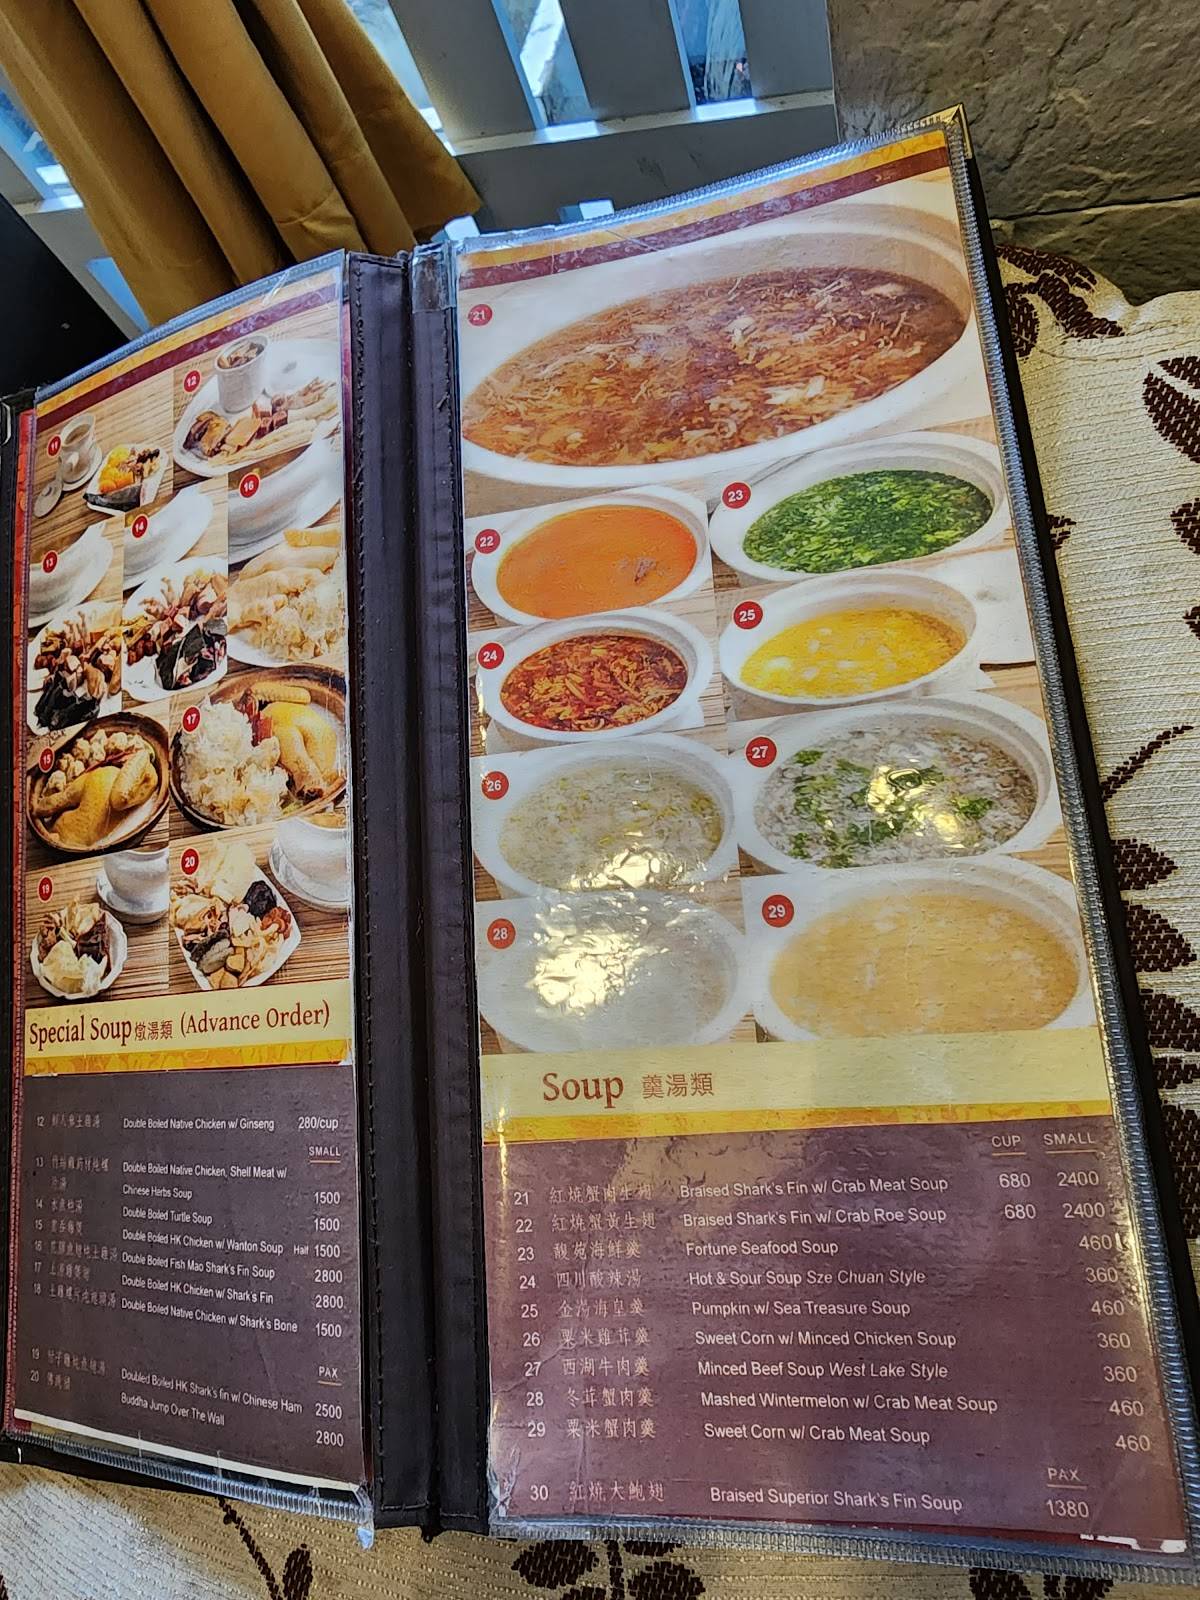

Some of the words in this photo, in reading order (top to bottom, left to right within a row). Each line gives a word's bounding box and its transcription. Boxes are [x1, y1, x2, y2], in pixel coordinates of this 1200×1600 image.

[728, 490, 743, 501] 23
[480, 536, 494, 547] 22
[740, 610, 755, 621] 25
[483, 651, 497, 662] 24
[752, 746, 768, 758] 27
[488, 780, 502, 792] 26
[185, 857, 195, 867] 20
[768, 906, 786, 918] 29
[493, 928, 508, 940] 28
[30, 1016, 84, 1050] Special
[90, 1017, 132, 1046] Soup
[134, 1020, 173, 1040] 燉湯類
[180, 1011, 260, 1038] (Advance
[266, 1000, 330, 1029] Order)
[542, 1073, 625, 1108] Soup
[642, 1072, 714, 1098] 羹湯類
[124, 1118, 146, 1128] Double
[148, 1118, 168, 1128] Boiled
[170, 1118, 193, 1129] Native
[195, 1118, 226, 1129] Chicken
[228, 1118, 238, 1129] w/
[240, 1118, 274, 1132] Ginseng
[298, 1116, 338, 1130] 280/cup
[992, 1136, 1021, 1147] CUP
[1043, 1133, 1096, 1146] SMALL
[309, 1146, 340, 1156] SMALL
[514, 1192, 528, 1205] 21
[680, 1184, 729, 1198] Braised
[733, 1182, 784, 1196] Shark's
[787, 1181, 808, 1194] Fin
[812, 1180, 827, 1193] w/
[832, 1179, 866, 1193] Crab
[870, 1178, 906, 1192] Meat
[910, 1178, 948, 1192] Soup
[999, 1172, 1030, 1188] 680
[1056, 1171, 1099, 1186] 2400
[314, 1192, 340, 1204] 1500
[516, 1219, 532, 1233] 22
[683, 1212, 732, 1226] Braised
[736, 1211, 786, 1225] Shark's
[790, 1210, 812, 1224] Fin
[816, 1210, 832, 1223] w/
[836, 1209, 870, 1223] Crab
[874, 1208, 904, 1222] Roe
[908, 1208, 946, 1222] Soup
[1004, 1204, 1036, 1219] 680
[1062, 1202, 1105, 1218] 2400
[314, 1218, 340, 1232] 1500
[314, 1244, 340, 1258] 1500
[518, 1247, 535, 1261] 23
[686, 1242, 737, 1256] Fortune
[740, 1240, 798, 1254] Seafood
[802, 1240, 838, 1256] Soup
[1078, 1234, 1112, 1250] 460
[314, 1270, 342, 1283] 2800
[520, 1276, 536, 1290] 24
[689, 1272, 713, 1285] Hot
[716, 1273, 726, 1284] &
[730, 1272, 762, 1285] Sour
[766, 1271, 802, 1287] Soup
[806, 1270, 832, 1284] Sze
[838, 1270, 884, 1284] Chuan
[888, 1270, 926, 1287] Style
[1085, 1267, 1118, 1283] 360
[316, 1294, 344, 1308] 2800
[521, 1304, 538, 1318] 25
[692, 1302, 750, 1317] Pumpkin
[754, 1301, 770, 1314] w/
[774, 1301, 800, 1314] Sea
[804, 1301, 868, 1314] Treasure
[872, 1301, 910, 1316] Soup
[1091, 1300, 1124, 1316] 460
[122, 1298, 146, 1312] Double
[148, 1302, 168, 1315] Boiled
[170, 1304, 194, 1320] Native
[195, 1310, 226, 1324] Chicken
[228, 1314, 238, 1324] w/
[240, 1315, 272, 1330] Shark's
[274, 1318, 298, 1332] Bone
[316, 1323, 342, 1338] 1500
[523, 1332, 540, 1347] 26
[695, 1330, 737, 1345] Sweet
[740, 1331, 774, 1345] Corn
[778, 1332, 794, 1345] w/
[798, 1331, 849, 1346] Minced
[853, 1332, 913, 1346] Chicken
[917, 1332, 956, 1348] Soup
[1098, 1332, 1130, 1348] 360
[318, 1366, 338, 1378] PAX
[524, 1362, 542, 1377] 27
[698, 1361, 748, 1376] Minced
[751, 1361, 784, 1376] Beef
[787, 1362, 824, 1379] Soup
[828, 1362, 866, 1377] West
[870, 1363, 905, 1378] Lake
[910, 1363, 948, 1382] Style
[1104, 1366, 1137, 1382] 360
[122, 1368, 150, 1384] Doubled
[176, 1380, 188, 1392] HK
[190, 1382, 218, 1398] Shark's
[220, 1390, 229, 1400] fin
[232, 1393, 240, 1402] w/
[242, 1392, 278, 1410] Chinese
[280, 1399, 302, 1414] Ham
[315, 1403, 342, 1419] 2500
[526, 1392, 544, 1406] 28
[701, 1392, 756, 1406] Mashed
[758, 1392, 849, 1408] Wintermelon
[853, 1394, 870, 1408] w/
[873, 1395, 910, 1410] Crab
[914, 1396, 953, 1410] Meat
[956, 1396, 998, 1414] Soup
[1109, 1400, 1144, 1416] 460
[316, 1430, 344, 1446] 2800
[528, 1422, 546, 1438] 29
[704, 1424, 748, 1438] Sweet
[750, 1425, 786, 1440] Corn
[790, 1426, 806, 1440] w/
[809, 1426, 845, 1440] Crab
[849, 1427, 886, 1442] Meat
[890, 1428, 930, 1444] Soup
[1116, 1435, 1150, 1451] 460
[1048, 1468, 1081, 1482] PAX
[530, 1484, 548, 1500] 30
[710, 1487, 764, 1504] Braised
[768, 1488, 829, 1508] Superior
[834, 1490, 889, 1508] Shark's
[892, 1493, 918, 1510] Fin
[922, 1494, 962, 1514] Soup
[1046, 1500, 1089, 1518] 1380
